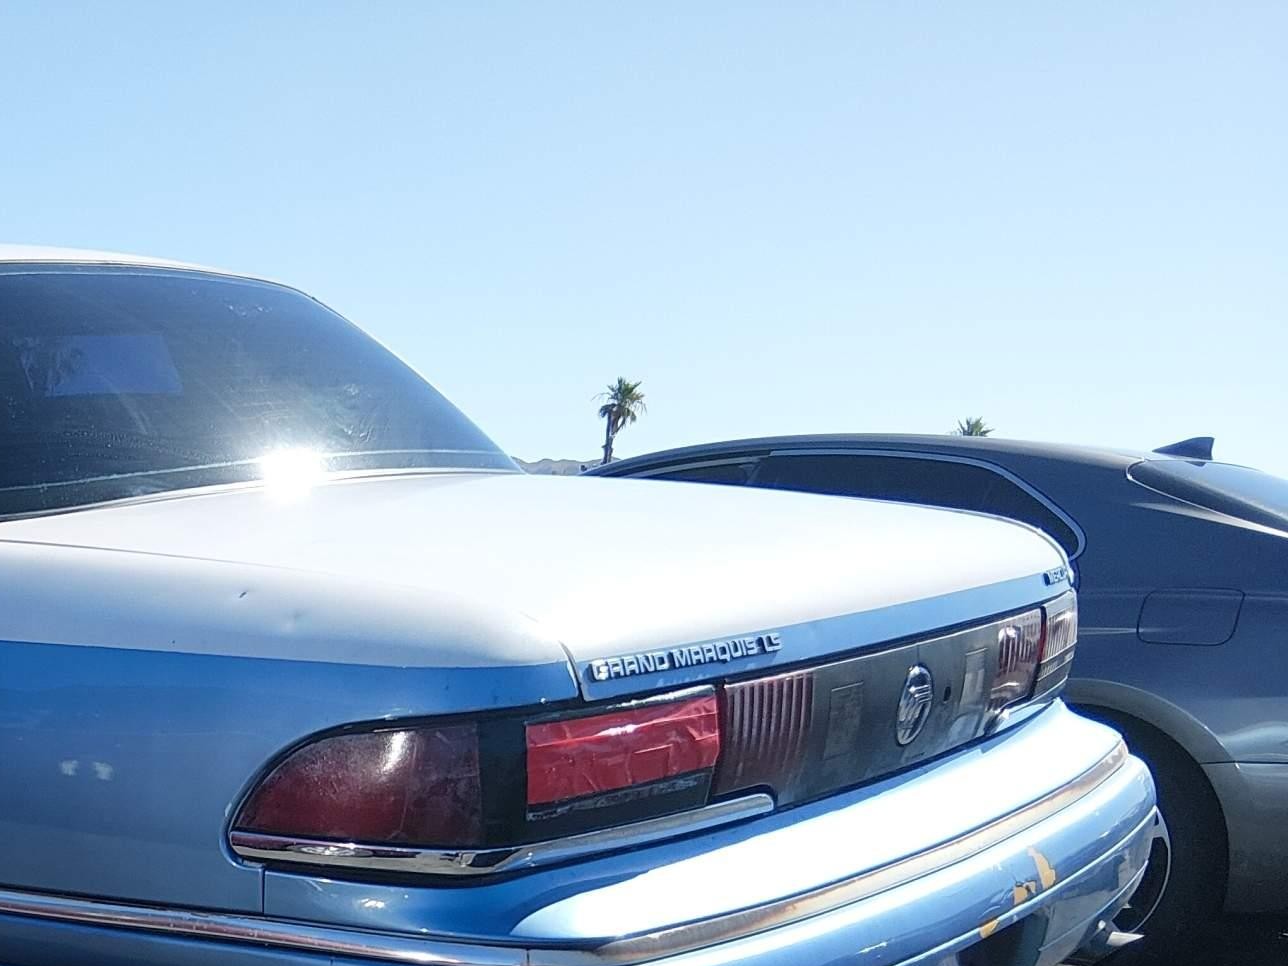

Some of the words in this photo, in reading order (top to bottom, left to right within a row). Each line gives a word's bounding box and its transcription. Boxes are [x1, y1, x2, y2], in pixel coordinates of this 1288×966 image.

[590, 650, 669, 680] GRAND
[670, 638, 759, 669] MARQUIS
[761, 632, 783, 652] LS
